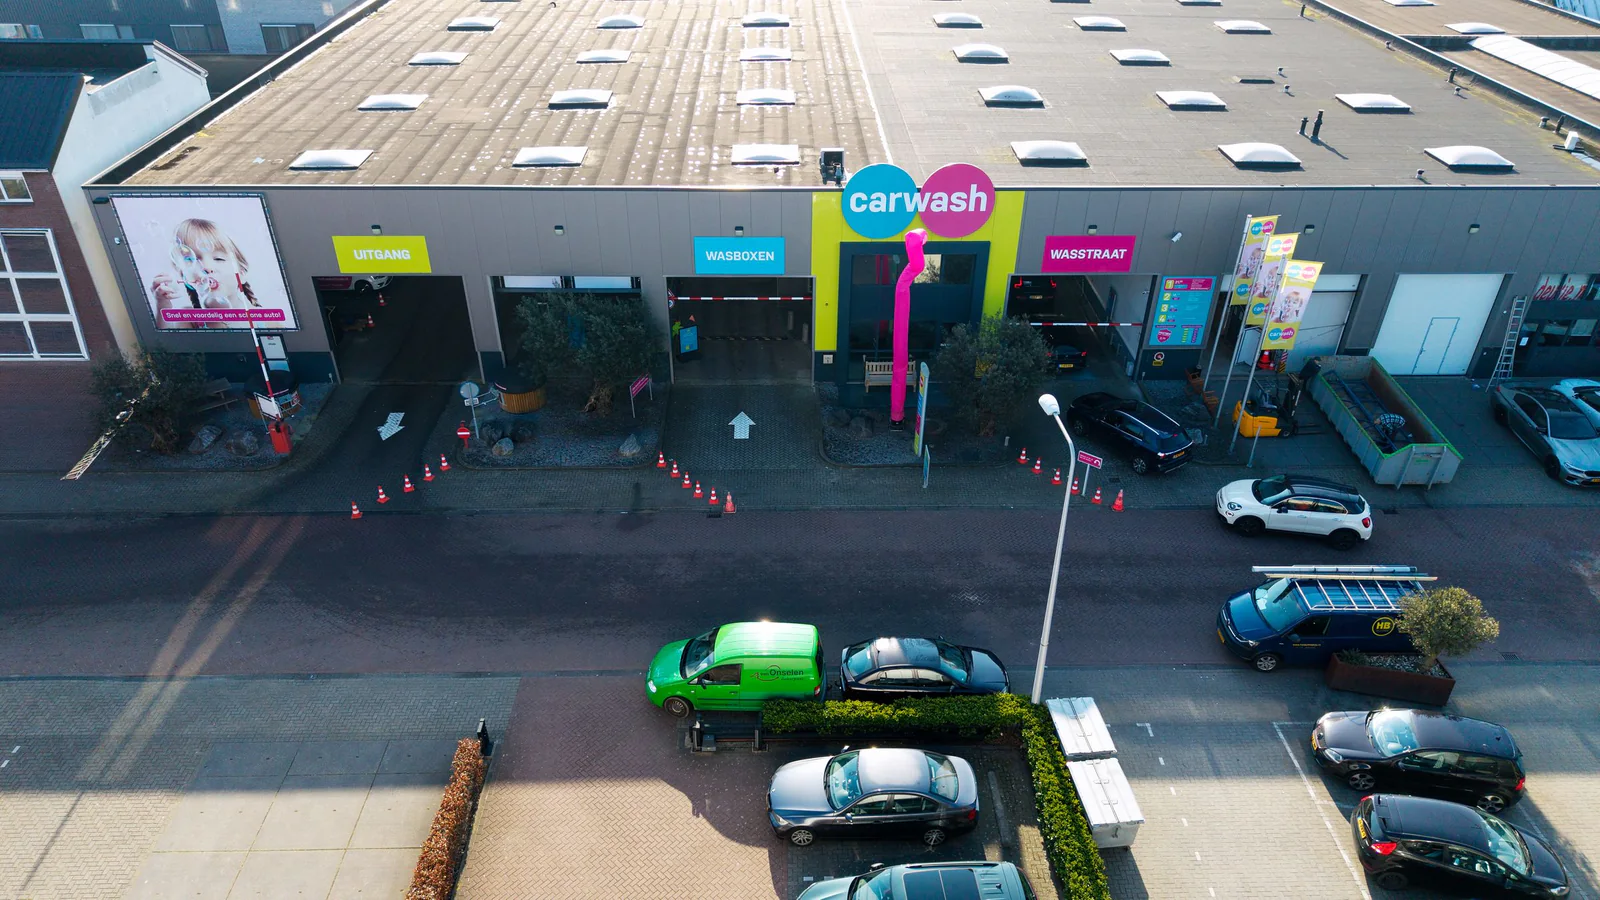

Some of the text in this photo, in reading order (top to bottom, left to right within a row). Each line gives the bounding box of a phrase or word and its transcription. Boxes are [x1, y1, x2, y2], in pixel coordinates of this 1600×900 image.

[850, 184, 988, 212] carwash
[353, 249, 411, 260] UITGANG
[705, 251, 775, 261] WASBOXEN
[1050, 248, 1128, 260] WASSTRAAT
[193, 312, 223, 320] voordelig
[1376, 621, 1391, 630] HB
